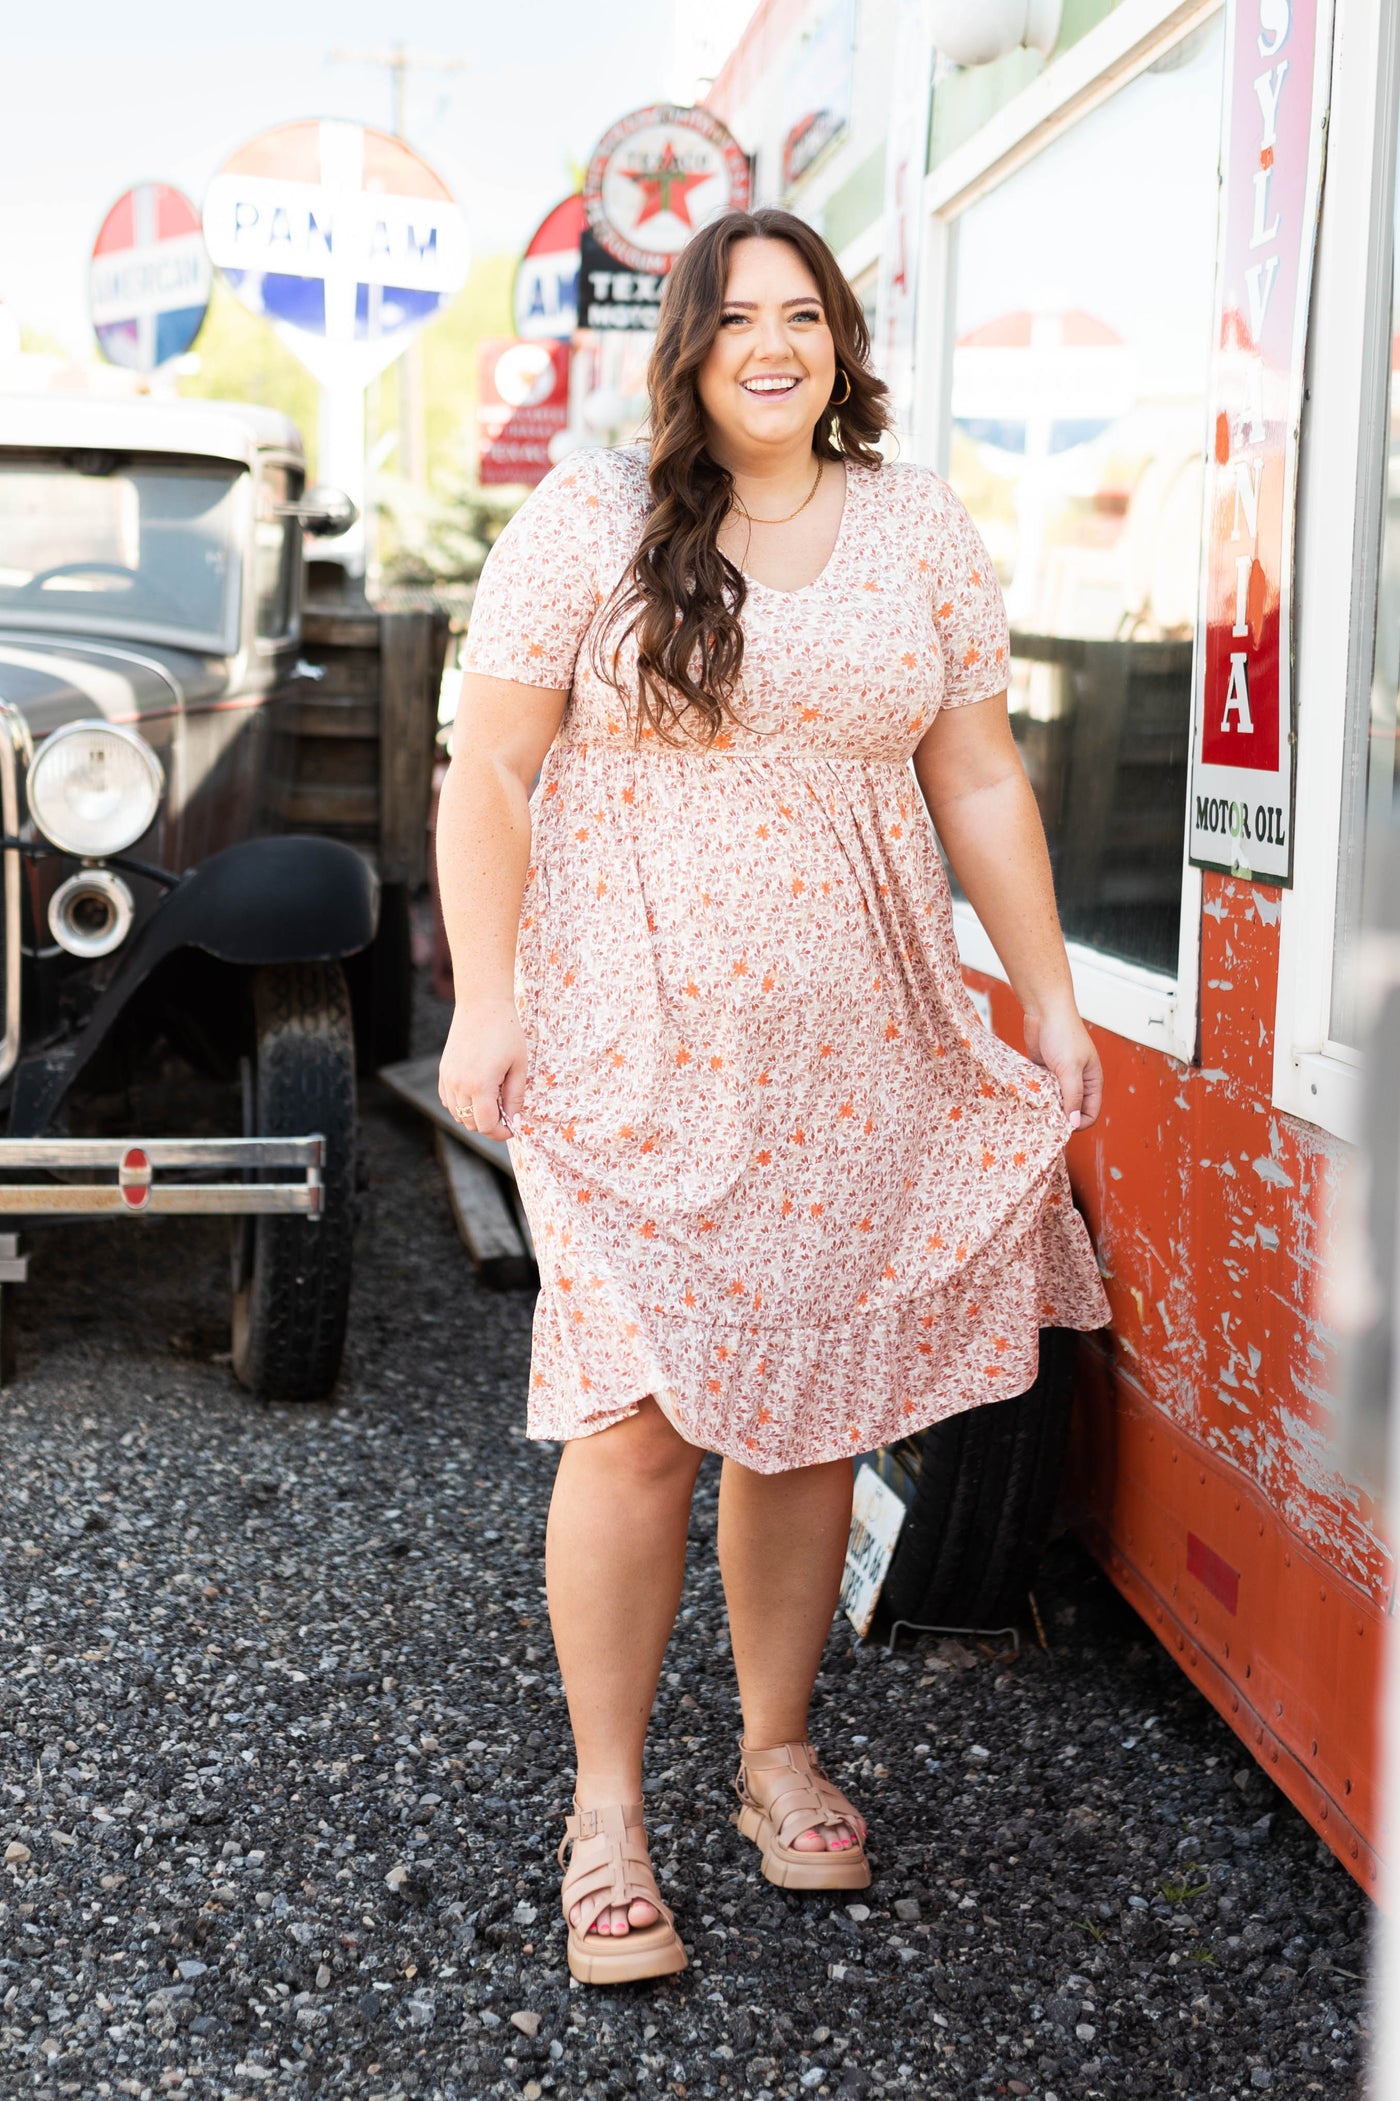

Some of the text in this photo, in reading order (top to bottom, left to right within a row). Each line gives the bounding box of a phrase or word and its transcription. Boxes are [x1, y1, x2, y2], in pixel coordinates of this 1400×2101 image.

[235, 201, 437, 262] PAN AM
[1220, 0, 1293, 734] SYLVANIA
[1196, 795, 1286, 846] MOTOR OIL
